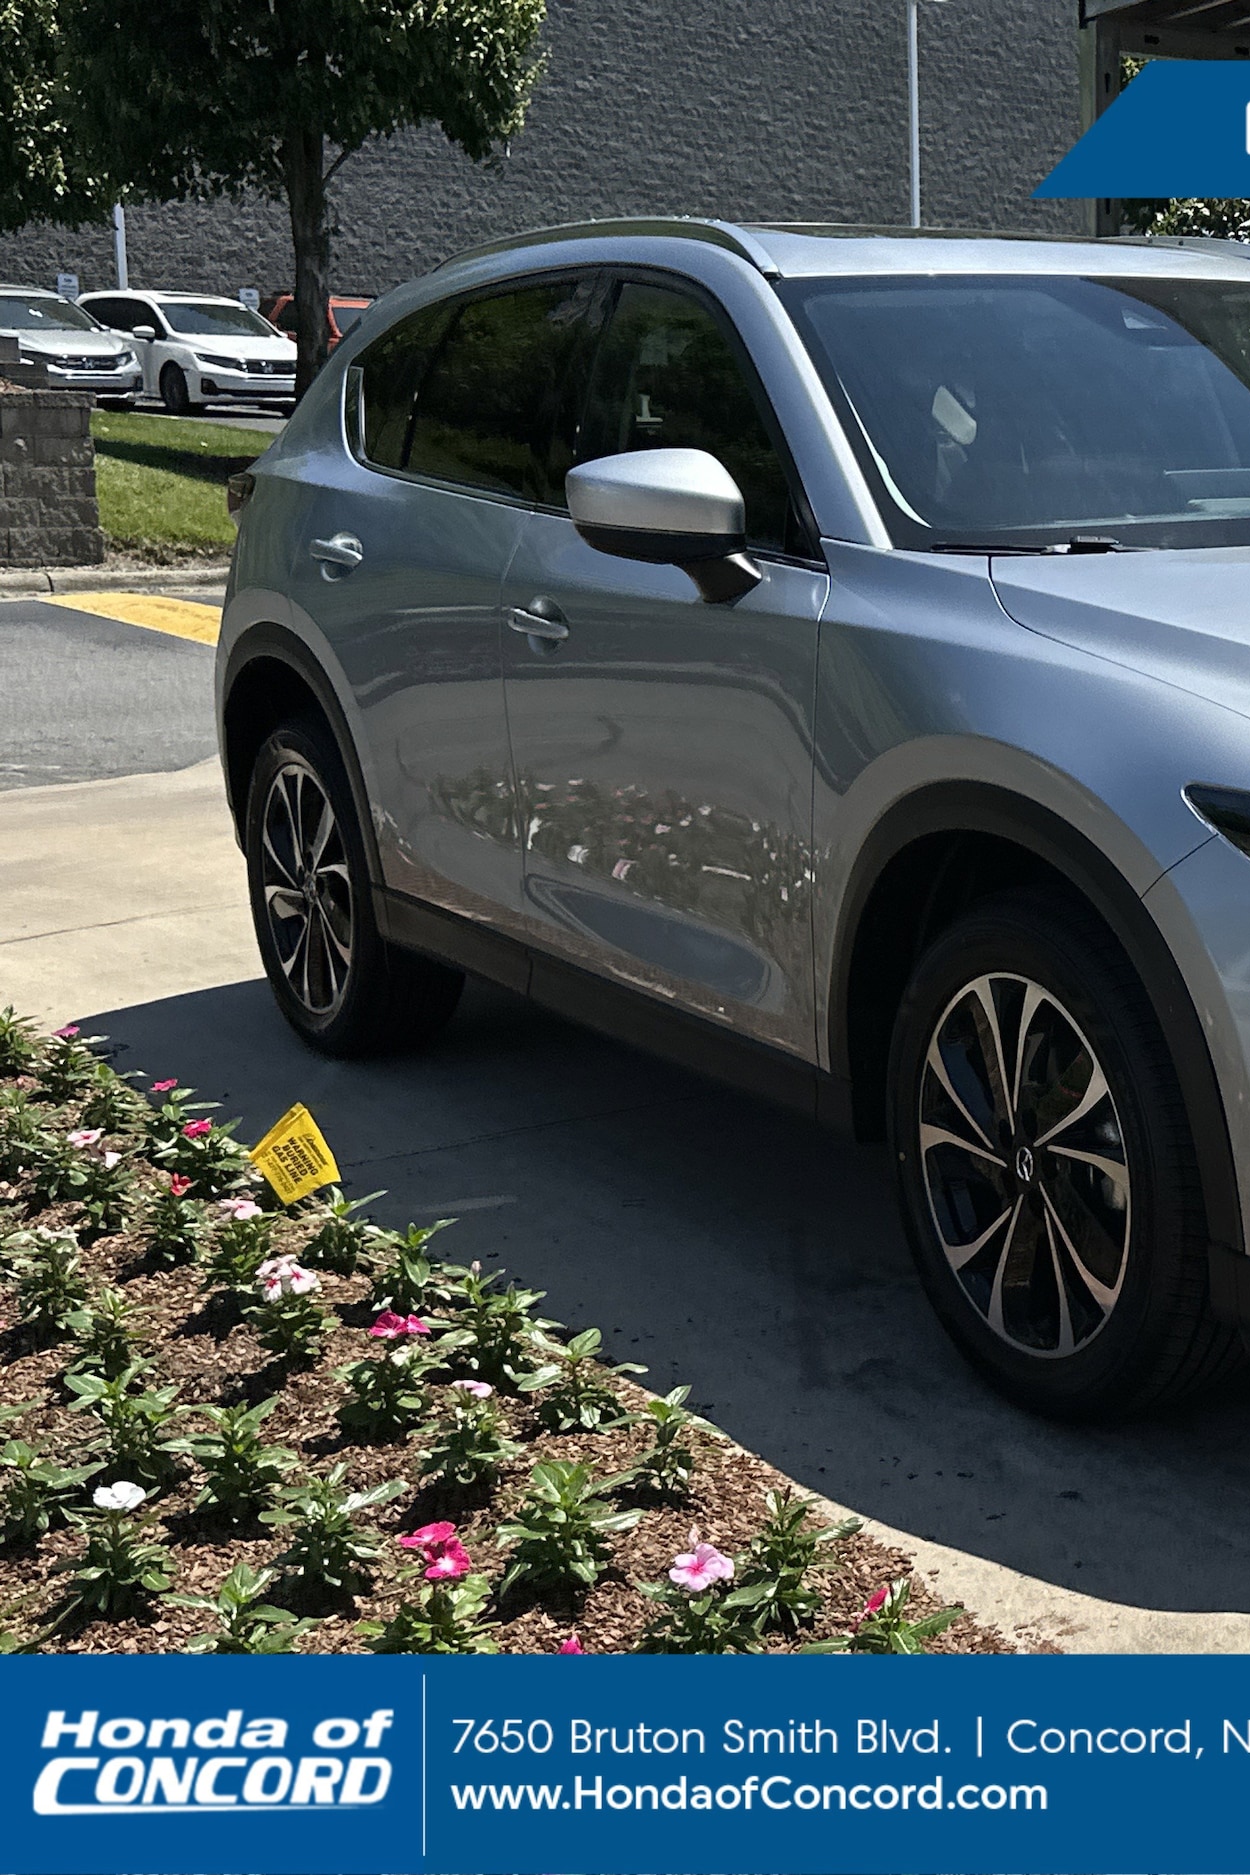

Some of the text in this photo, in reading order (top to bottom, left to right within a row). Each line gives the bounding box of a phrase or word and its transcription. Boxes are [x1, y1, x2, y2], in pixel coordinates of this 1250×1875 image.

[271, 1145, 289, 1163] GAS
[284, 1163, 303, 1185] LINE
[282, 1145, 308, 1176] BURIED
[287, 1137, 319, 1176] WARNING
